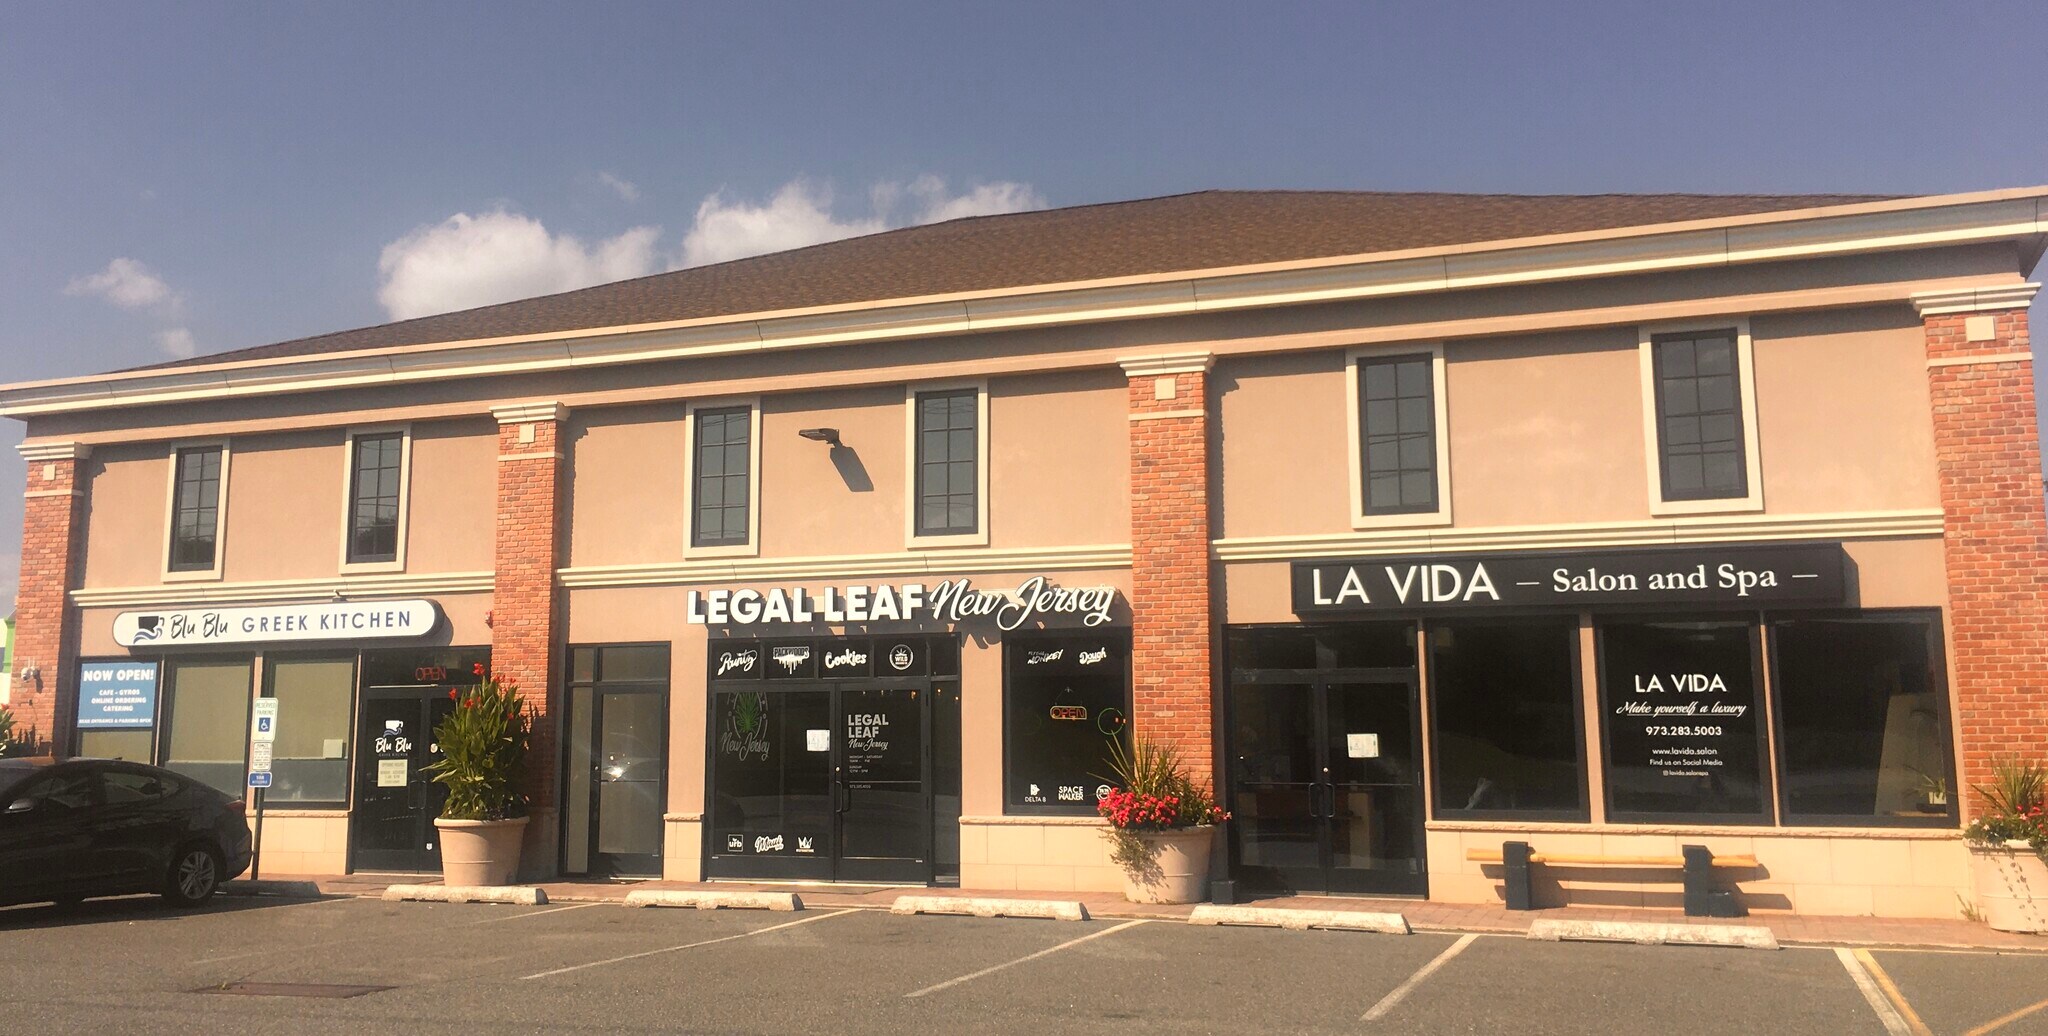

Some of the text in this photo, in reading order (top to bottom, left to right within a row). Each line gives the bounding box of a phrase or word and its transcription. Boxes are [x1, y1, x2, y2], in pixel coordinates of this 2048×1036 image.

[1312, 562, 1500, 605] LA VIDA
[1552, 563, 1778, 597] Salon and Spa
[687, 576, 1117, 632] LEGAL LEAF New Jersey
[170, 611, 411, 640] Blu Blu GREEK KITCHEN
[717, 649, 758, 676] Runtz
[825, 648, 867, 669] Cookies
[1079, 646, 1107, 665] Dough
[83, 669, 154, 681] NOW OPEN!
[415, 666, 447, 681] OPEN
[1634, 673, 1728, 693] LA VIDA
[119, 688, 140, 696] GYROS
[1052, 707, 1085, 718] OPEN
[1615, 701, 1747, 718] Make yourself a luxury
[847, 713, 890, 726] LEGAL
[848, 726, 880, 739] LEAF
[1645, 726, 1722, 737] 973.283.5003
[375, 737, 412, 754] Blu Blu
[721, 732, 770, 762] New Jersey
[848, 738, 889, 752] New Jersey
[1651, 747, 1718, 756] www.lavida.salon
[1649, 758, 1663, 766] Find
[1682, 758, 1701, 766] Social
[1702, 758, 1723, 766] Media
[1058, 785, 1084, 794] SPACE
[1058, 793, 1084, 801] WALKER
[728, 838, 743, 848] urb
